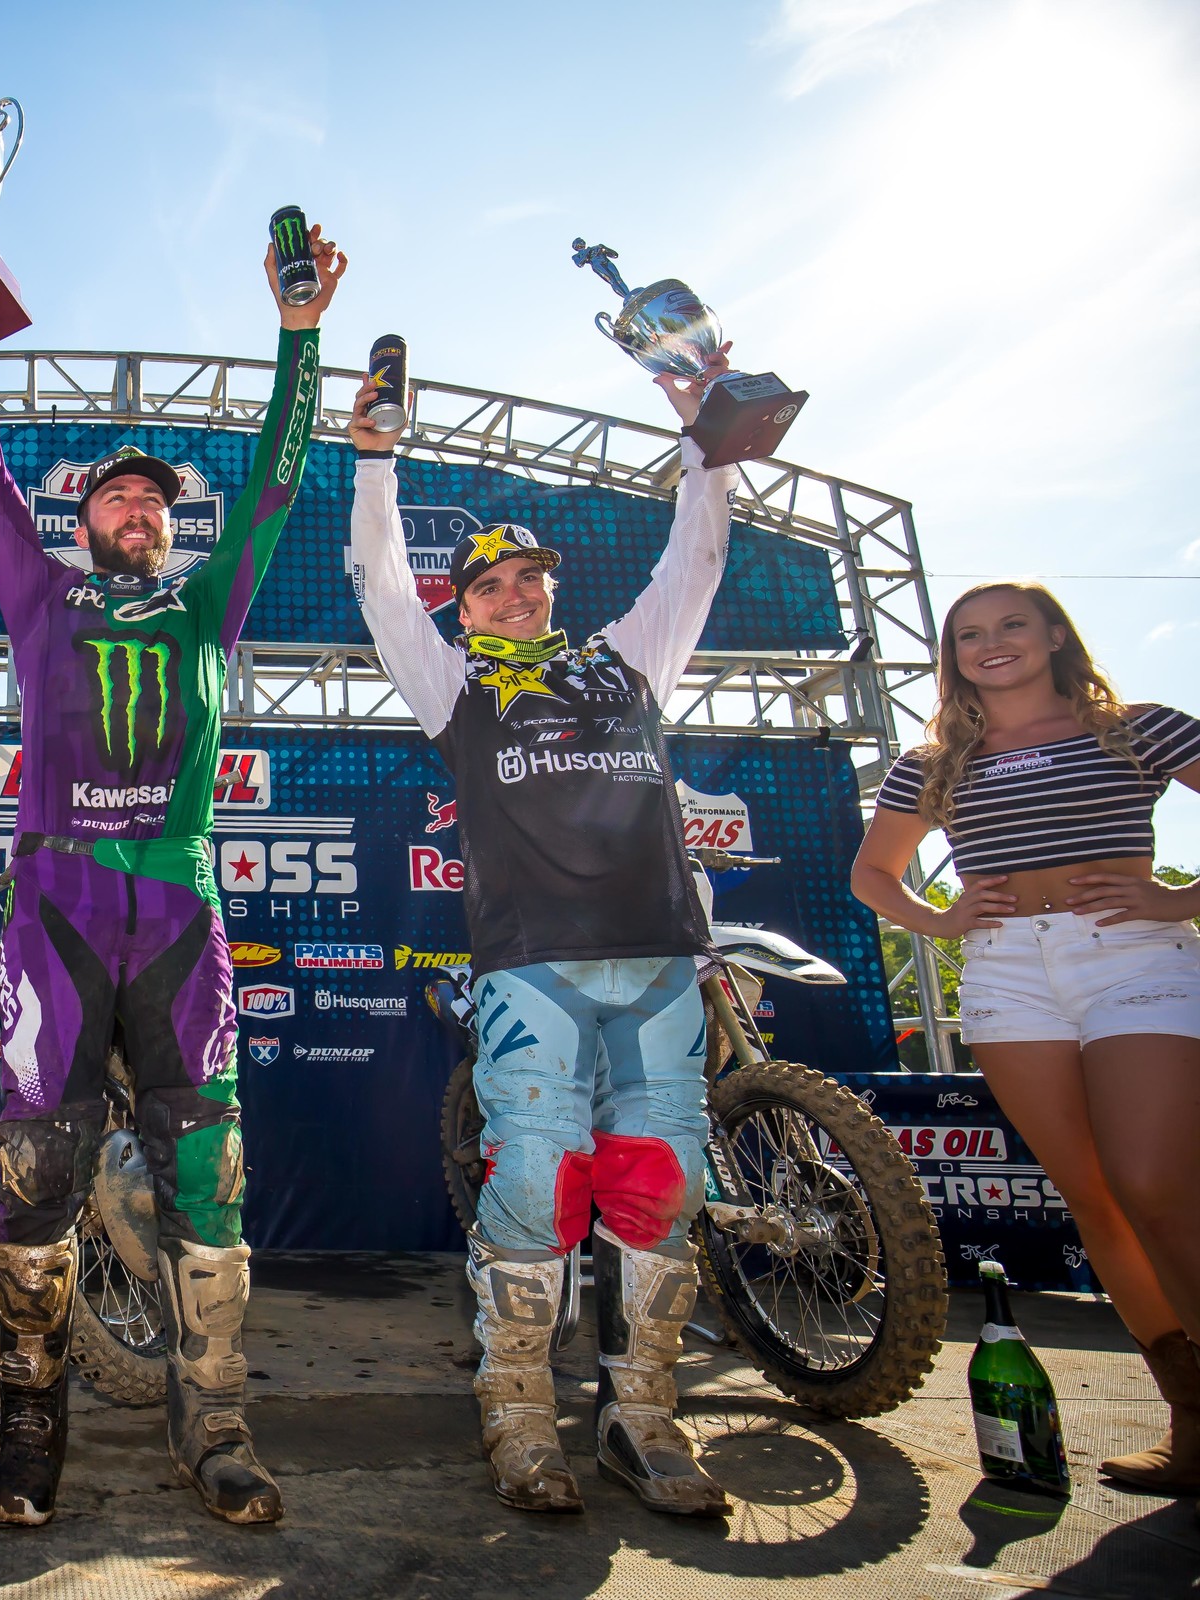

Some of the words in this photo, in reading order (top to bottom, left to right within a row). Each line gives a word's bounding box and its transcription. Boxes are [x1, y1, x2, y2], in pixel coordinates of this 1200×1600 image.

[401, 517, 465, 541] 019
[689, 808, 746, 816] PERFORMANCE
[81, 820, 129, 831] DUNLOP
[409, 846, 465, 892] Re
[295, 943, 383, 959] PARTS
[296, 958, 383, 969] UNLIMITED
[246, 992, 287, 1011] 100%
[333, 995, 406, 1010] Husqvarna
[257, 1047, 272, 1060] X
[309, 1048, 375, 1057] DUNLOP
[944, 1129, 999, 1157] OIL
